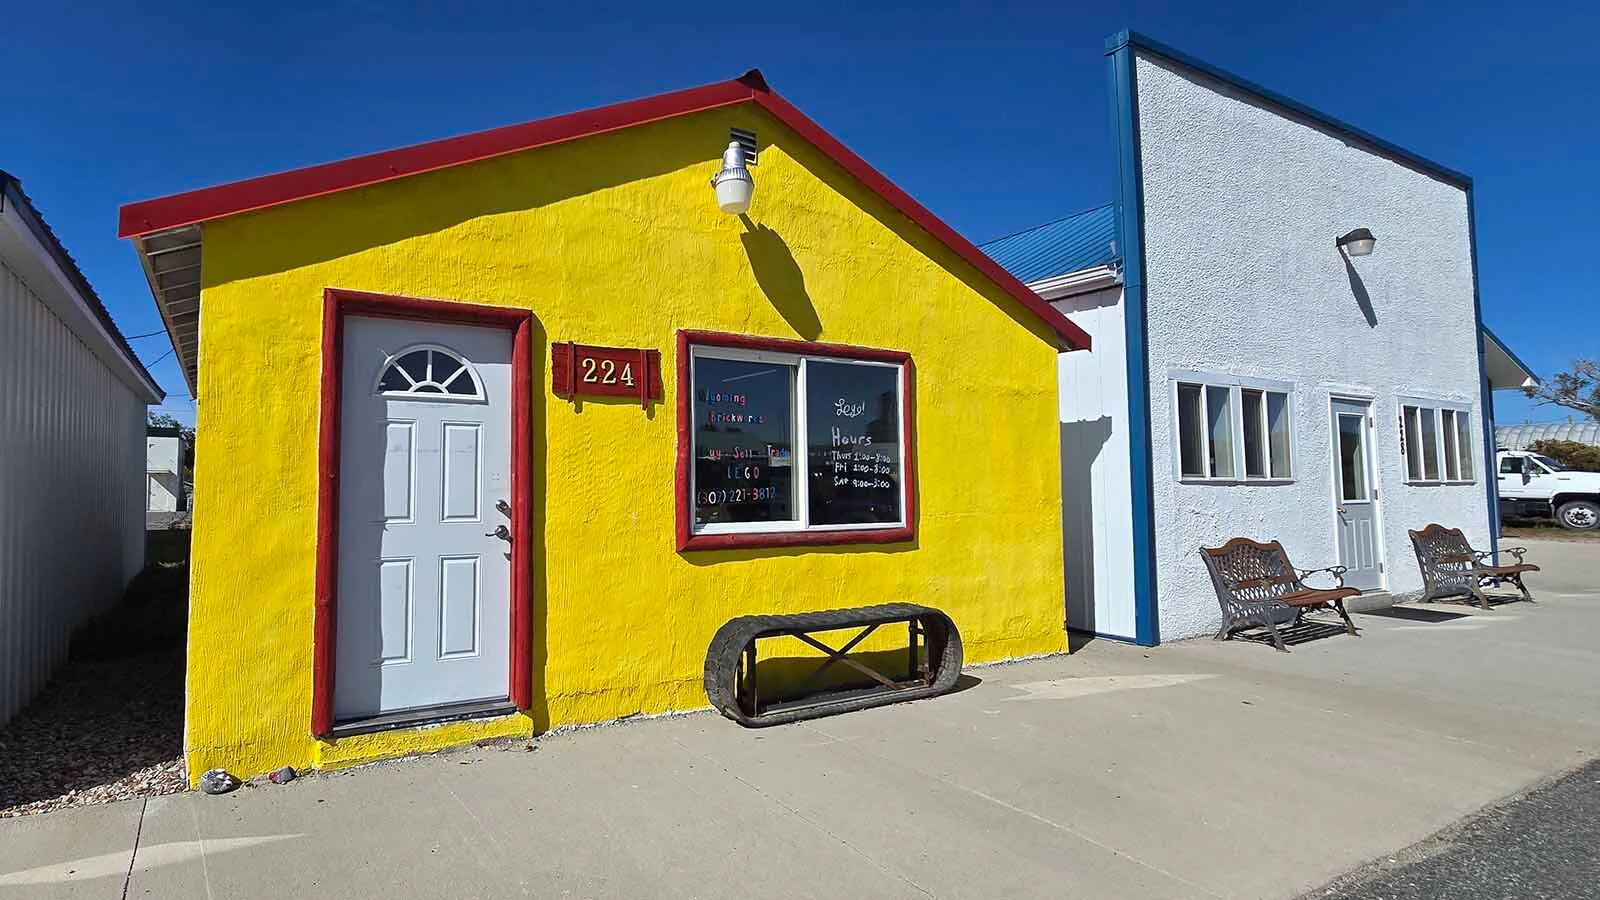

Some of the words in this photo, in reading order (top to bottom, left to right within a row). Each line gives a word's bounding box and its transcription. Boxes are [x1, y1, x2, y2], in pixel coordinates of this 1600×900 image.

[582, 358, 634, 386] 224
[834, 398, 865, 418] Lego!
[832, 426, 872, 447] Hours
[734, 446, 753, 459] Sell
[727, 466, 760, 479] LEGO
[835, 462, 847, 473] Fri
